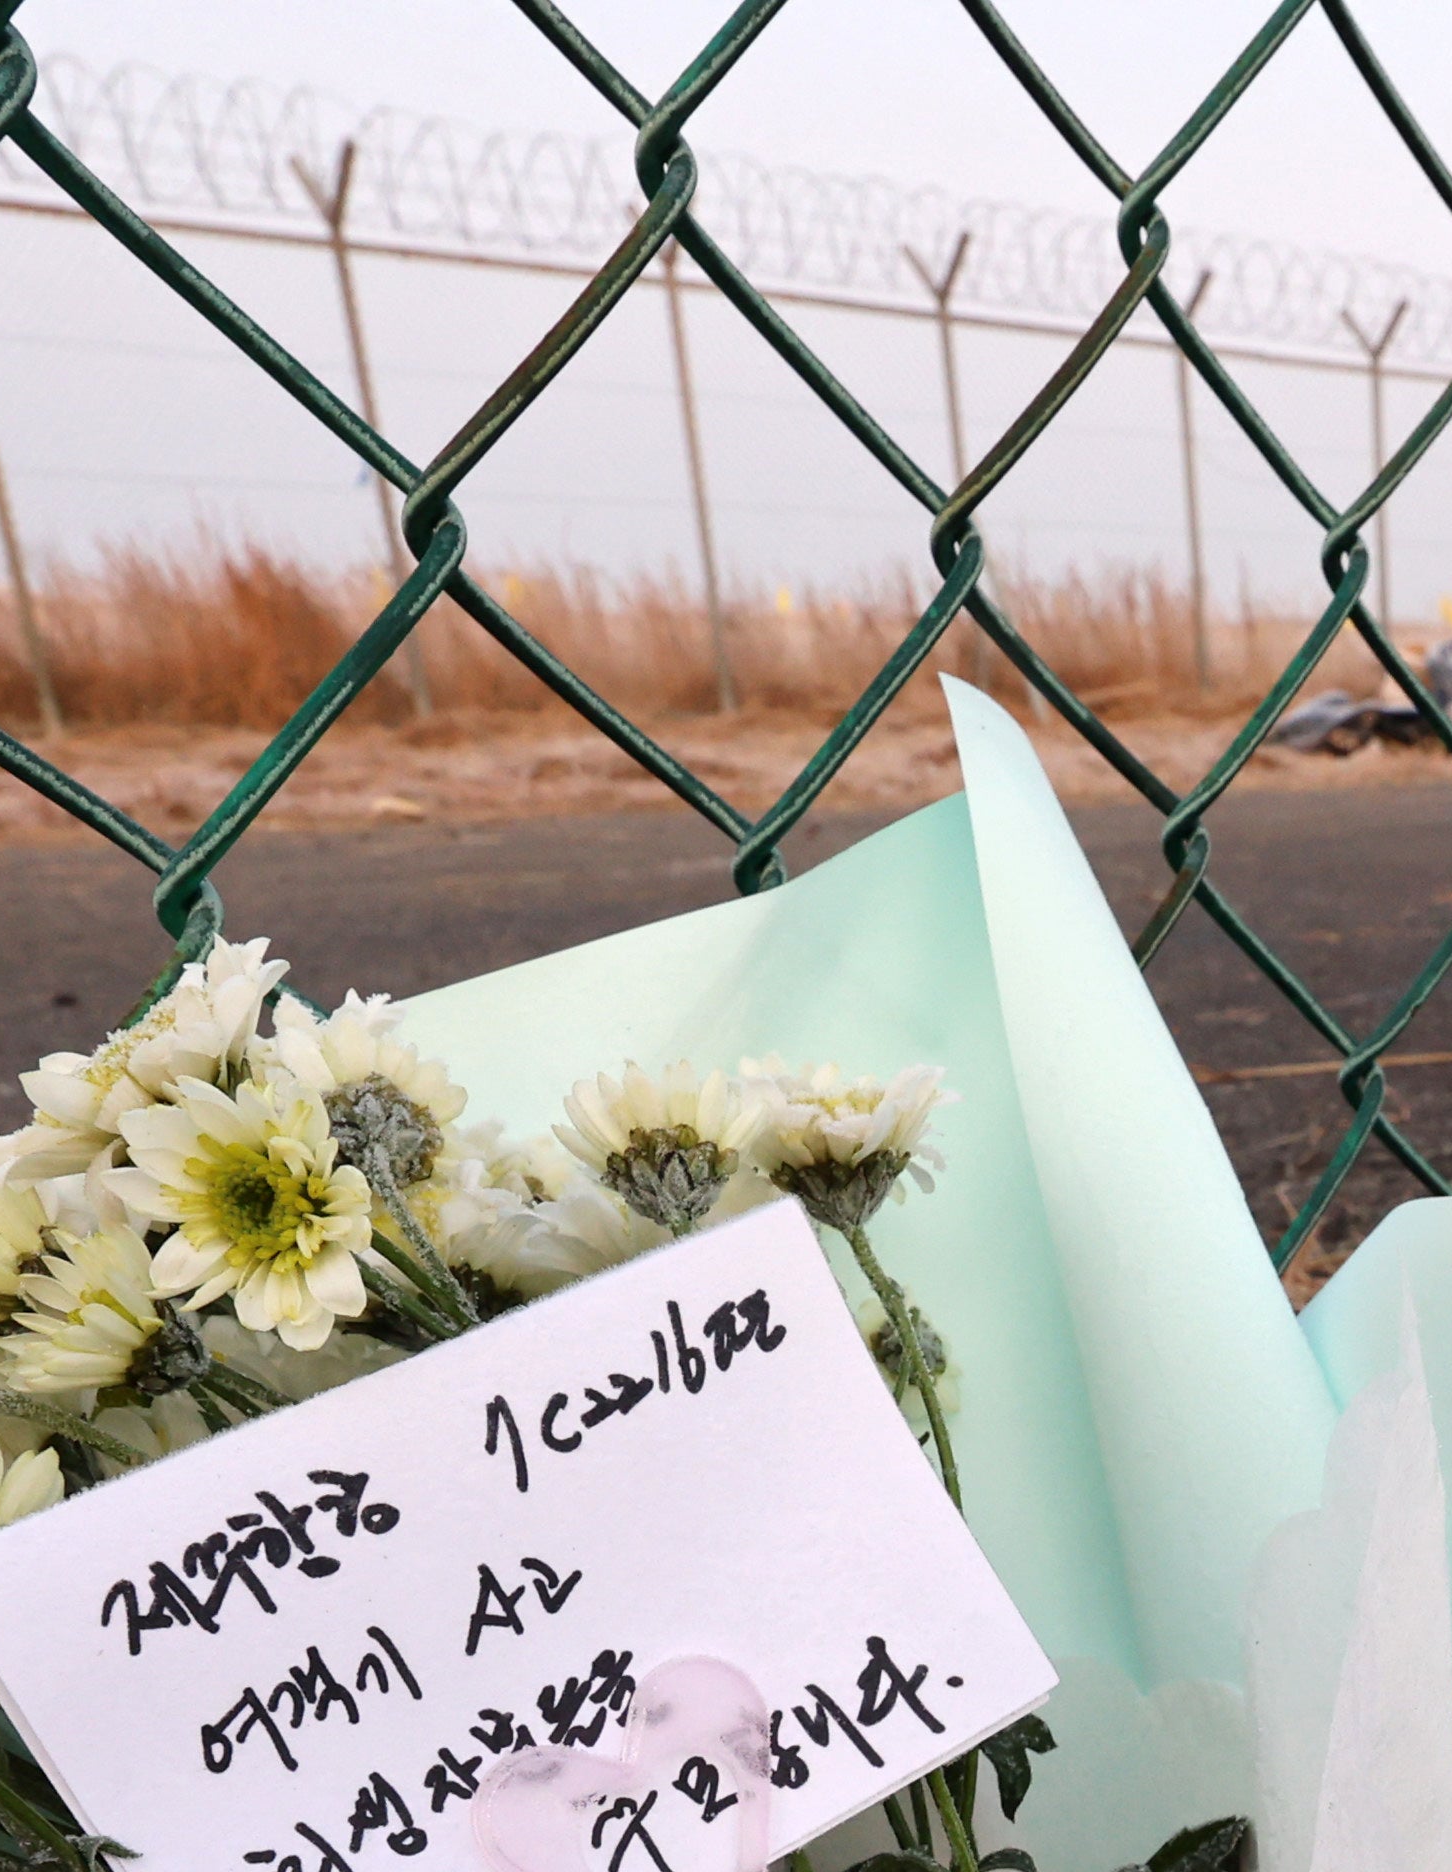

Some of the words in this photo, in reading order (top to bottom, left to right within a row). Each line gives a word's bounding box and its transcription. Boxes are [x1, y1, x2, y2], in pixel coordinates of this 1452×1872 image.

[102, 1470, 399, 1655] 제주항공
[201, 1627, 422, 1772] 여객기
[466, 1557, 582, 1656] 사고
